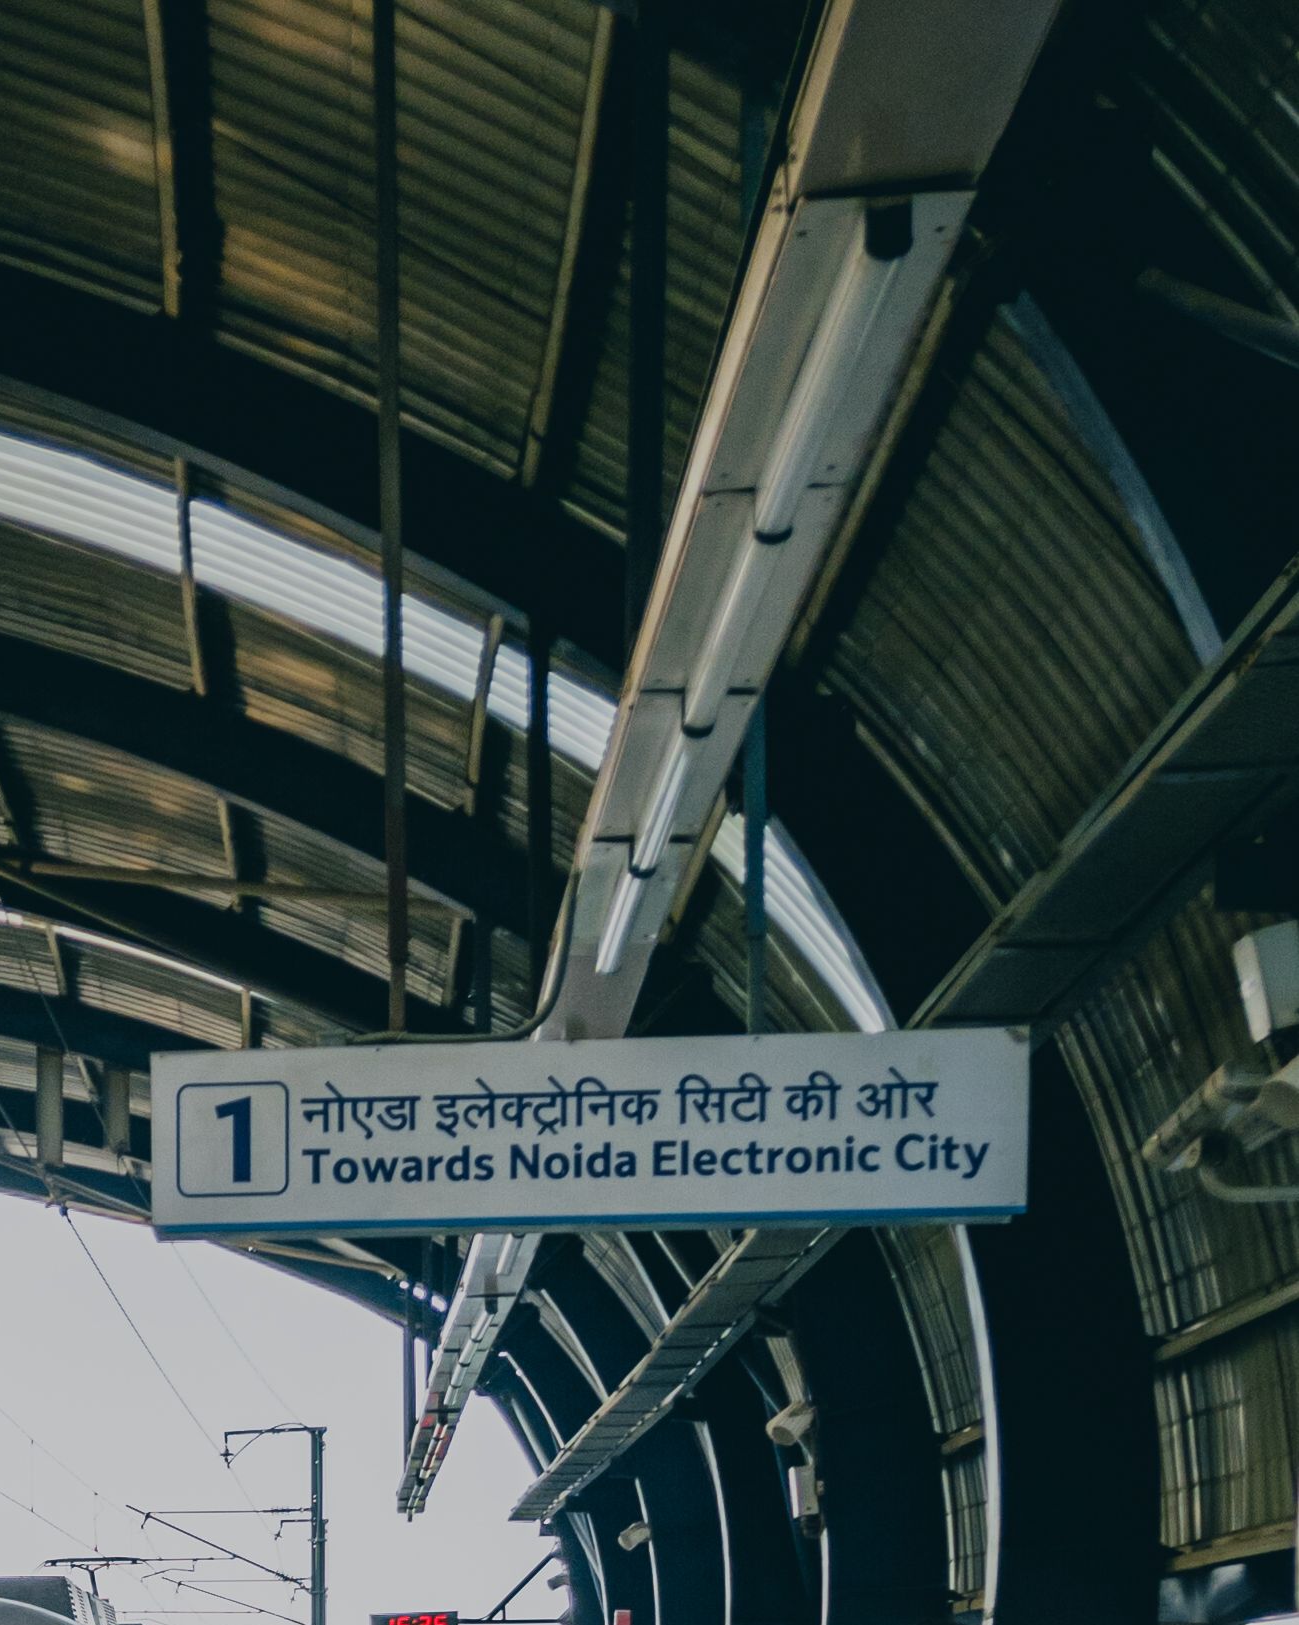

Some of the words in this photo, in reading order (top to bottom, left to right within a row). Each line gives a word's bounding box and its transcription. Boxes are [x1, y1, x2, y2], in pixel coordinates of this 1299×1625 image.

[301, 1081, 421, 1139] नोएडा
[675, 1072, 771, 1124] सिटी
[784, 1070, 842, 1121] की
[856, 1066, 939, 1119] ओर
[215, 1096, 251, 1183] 1
[302, 1145, 495, 1184] Towards
[509, 1142, 637, 1180] Noida
[652, 1135, 881, 1177] Electronic
[895, 1133, 990, 1180] City
